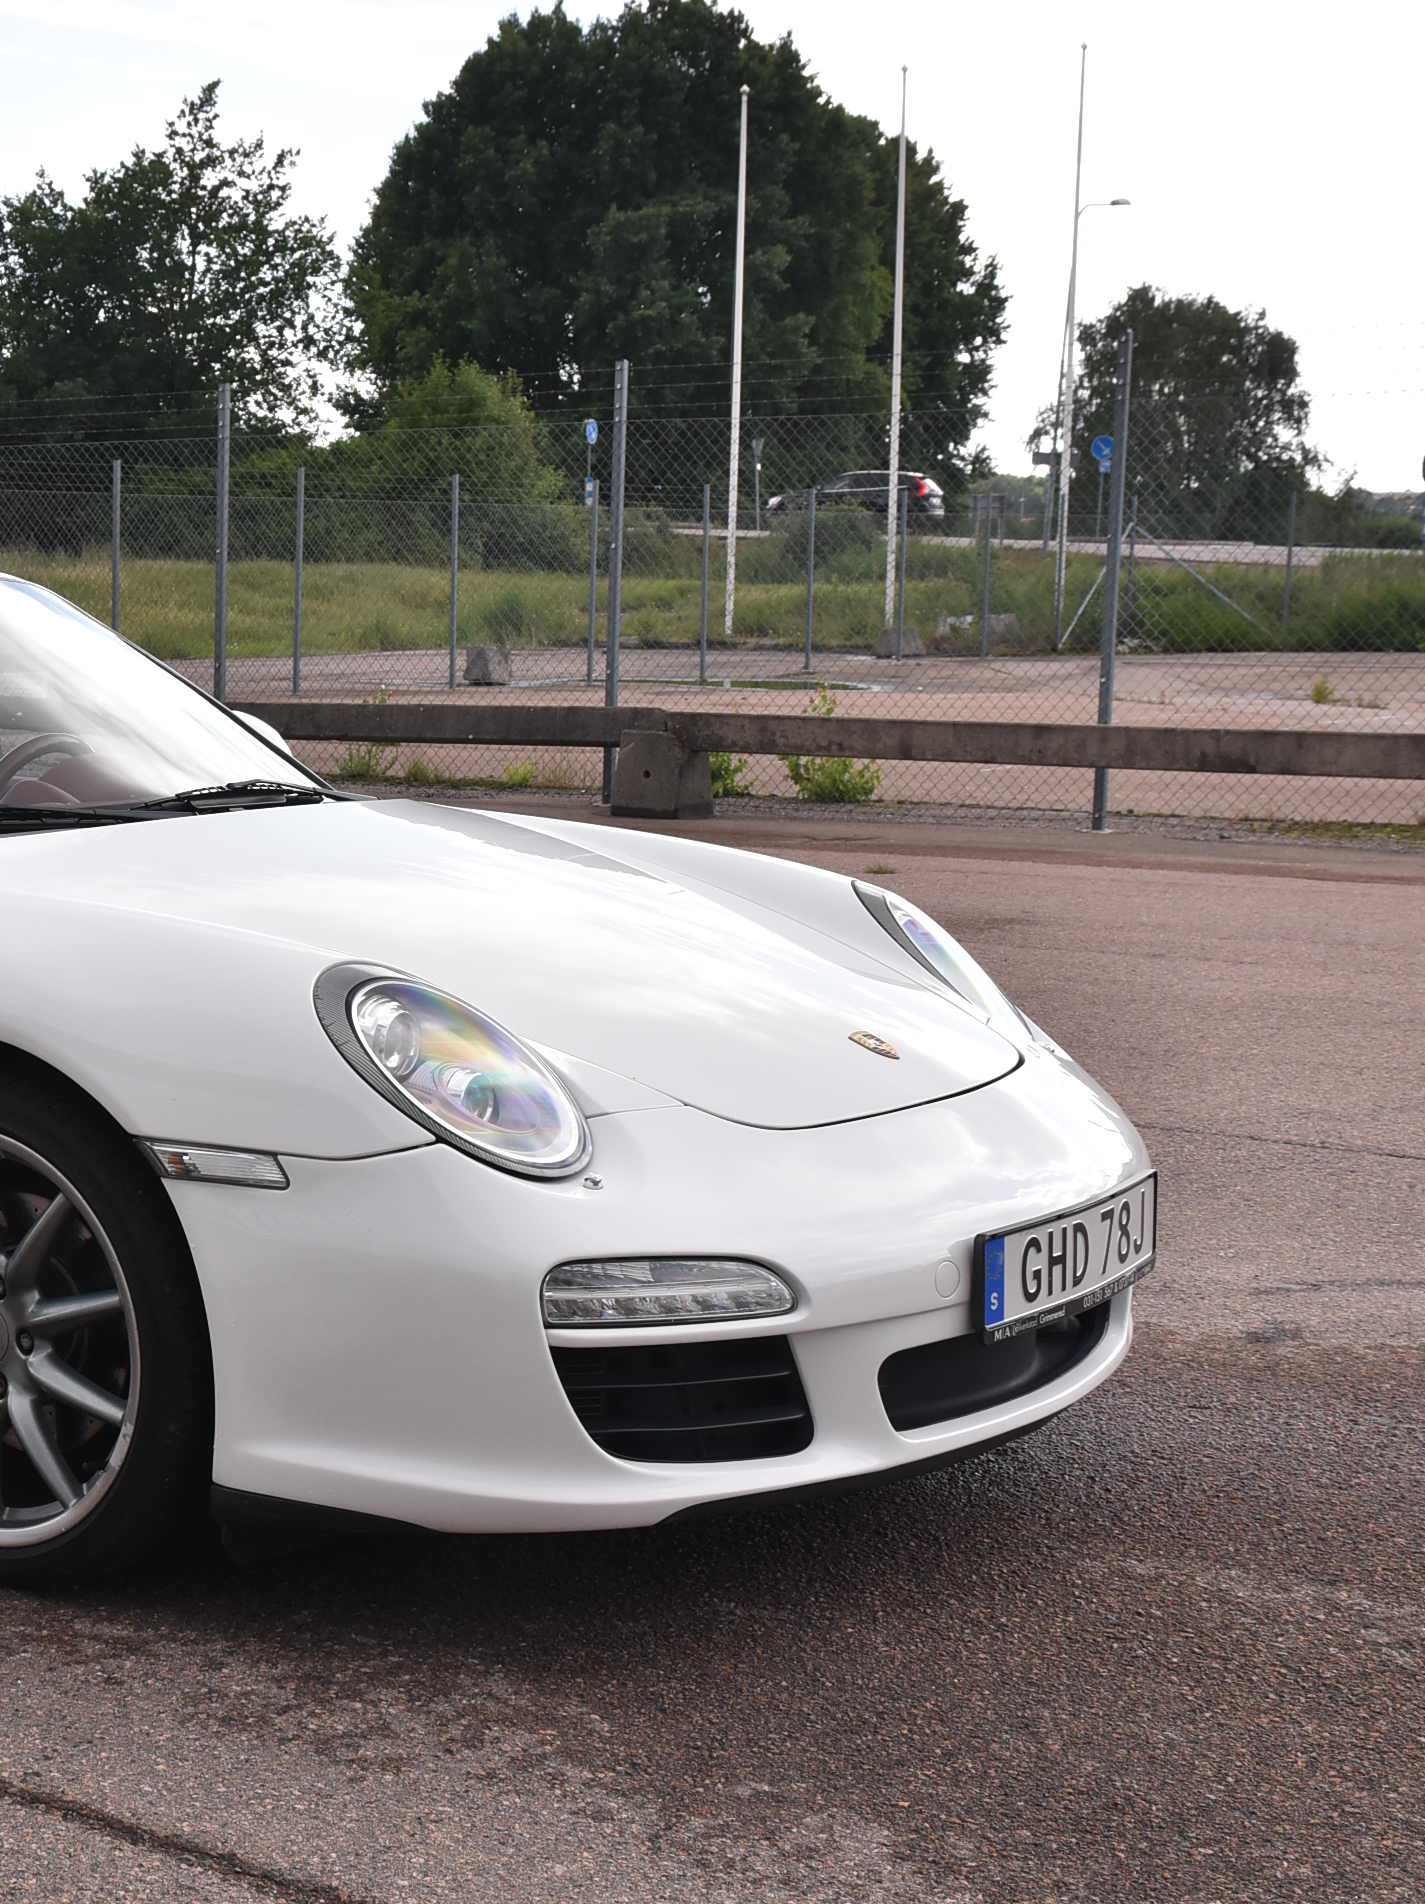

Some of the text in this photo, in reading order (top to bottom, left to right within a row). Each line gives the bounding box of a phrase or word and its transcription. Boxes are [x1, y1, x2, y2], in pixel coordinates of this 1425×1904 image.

[1021, 1188, 1145, 1303] GHD 78J
[990, 1292, 999, 1311] S
